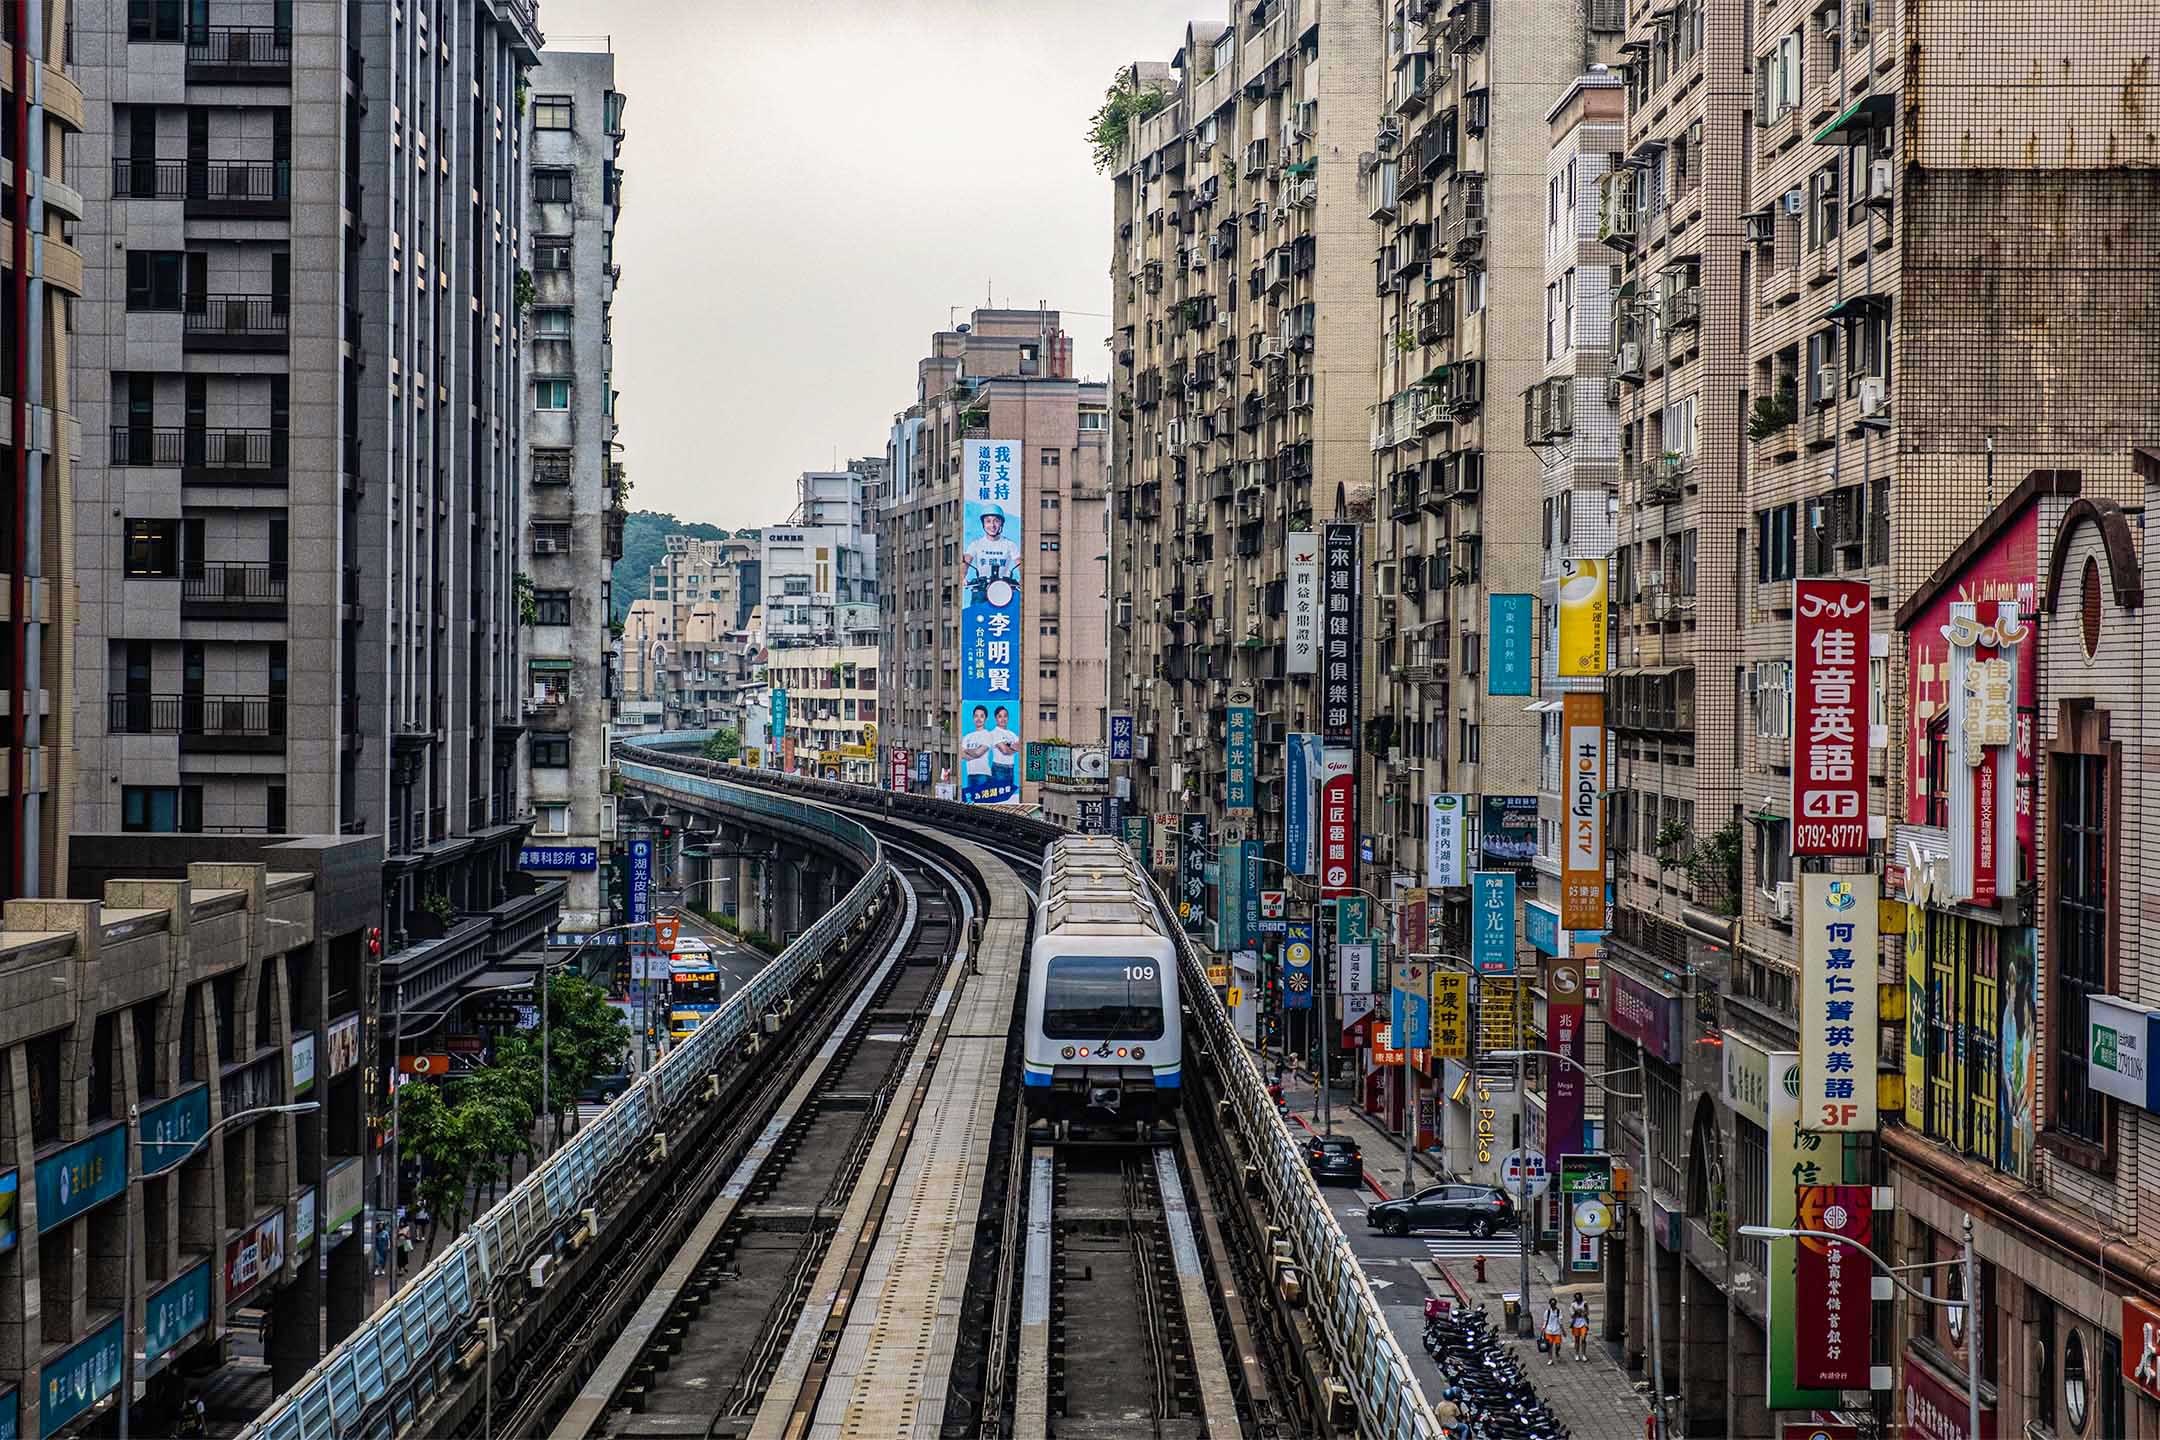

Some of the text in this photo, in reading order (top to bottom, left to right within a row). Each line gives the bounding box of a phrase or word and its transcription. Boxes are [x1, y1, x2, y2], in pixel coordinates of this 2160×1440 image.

[979, 446, 991, 500] 道路平權
[995, 446, 1010, 500] 我支持
[988, 613, 1010, 692] 李明賢
[1329, 549, 1349, 727] 來運動健身俱樂部
[1810, 628, 1855, 781] 佳音英語
[1984, 658, 2009, 745] 佳音英語
[1031, 744, 1041, 771] 眼科
[1113, 719, 1130, 757] 按摩
[1231, 713, 1244, 801] 吳振光眼科
[1330, 788, 1345, 860] 巨匠電腦
[1572, 744, 1597, 855] Holiday KTV
[1809, 795, 1854, 814] 4F
[580, 853, 594, 864] 3F
[1798, 825, 1863, 848] 8792-8777
[1330, 871, 1345, 881] 2F
[1485, 889, 1504, 931] 志光
[1123, 967, 1154, 980] 109
[1440, 976, 1459, 1045] 和慶中醫
[1825, 922, 1856, 1099] 何嘉仁菁英美語
[1376, 1053, 1405, 1063] 康是美
[1479, 1079, 1495, 1163] Le Polka
[1822, 1104, 1858, 1126] 3F
[1589, 1213, 1595, 1222] 9
